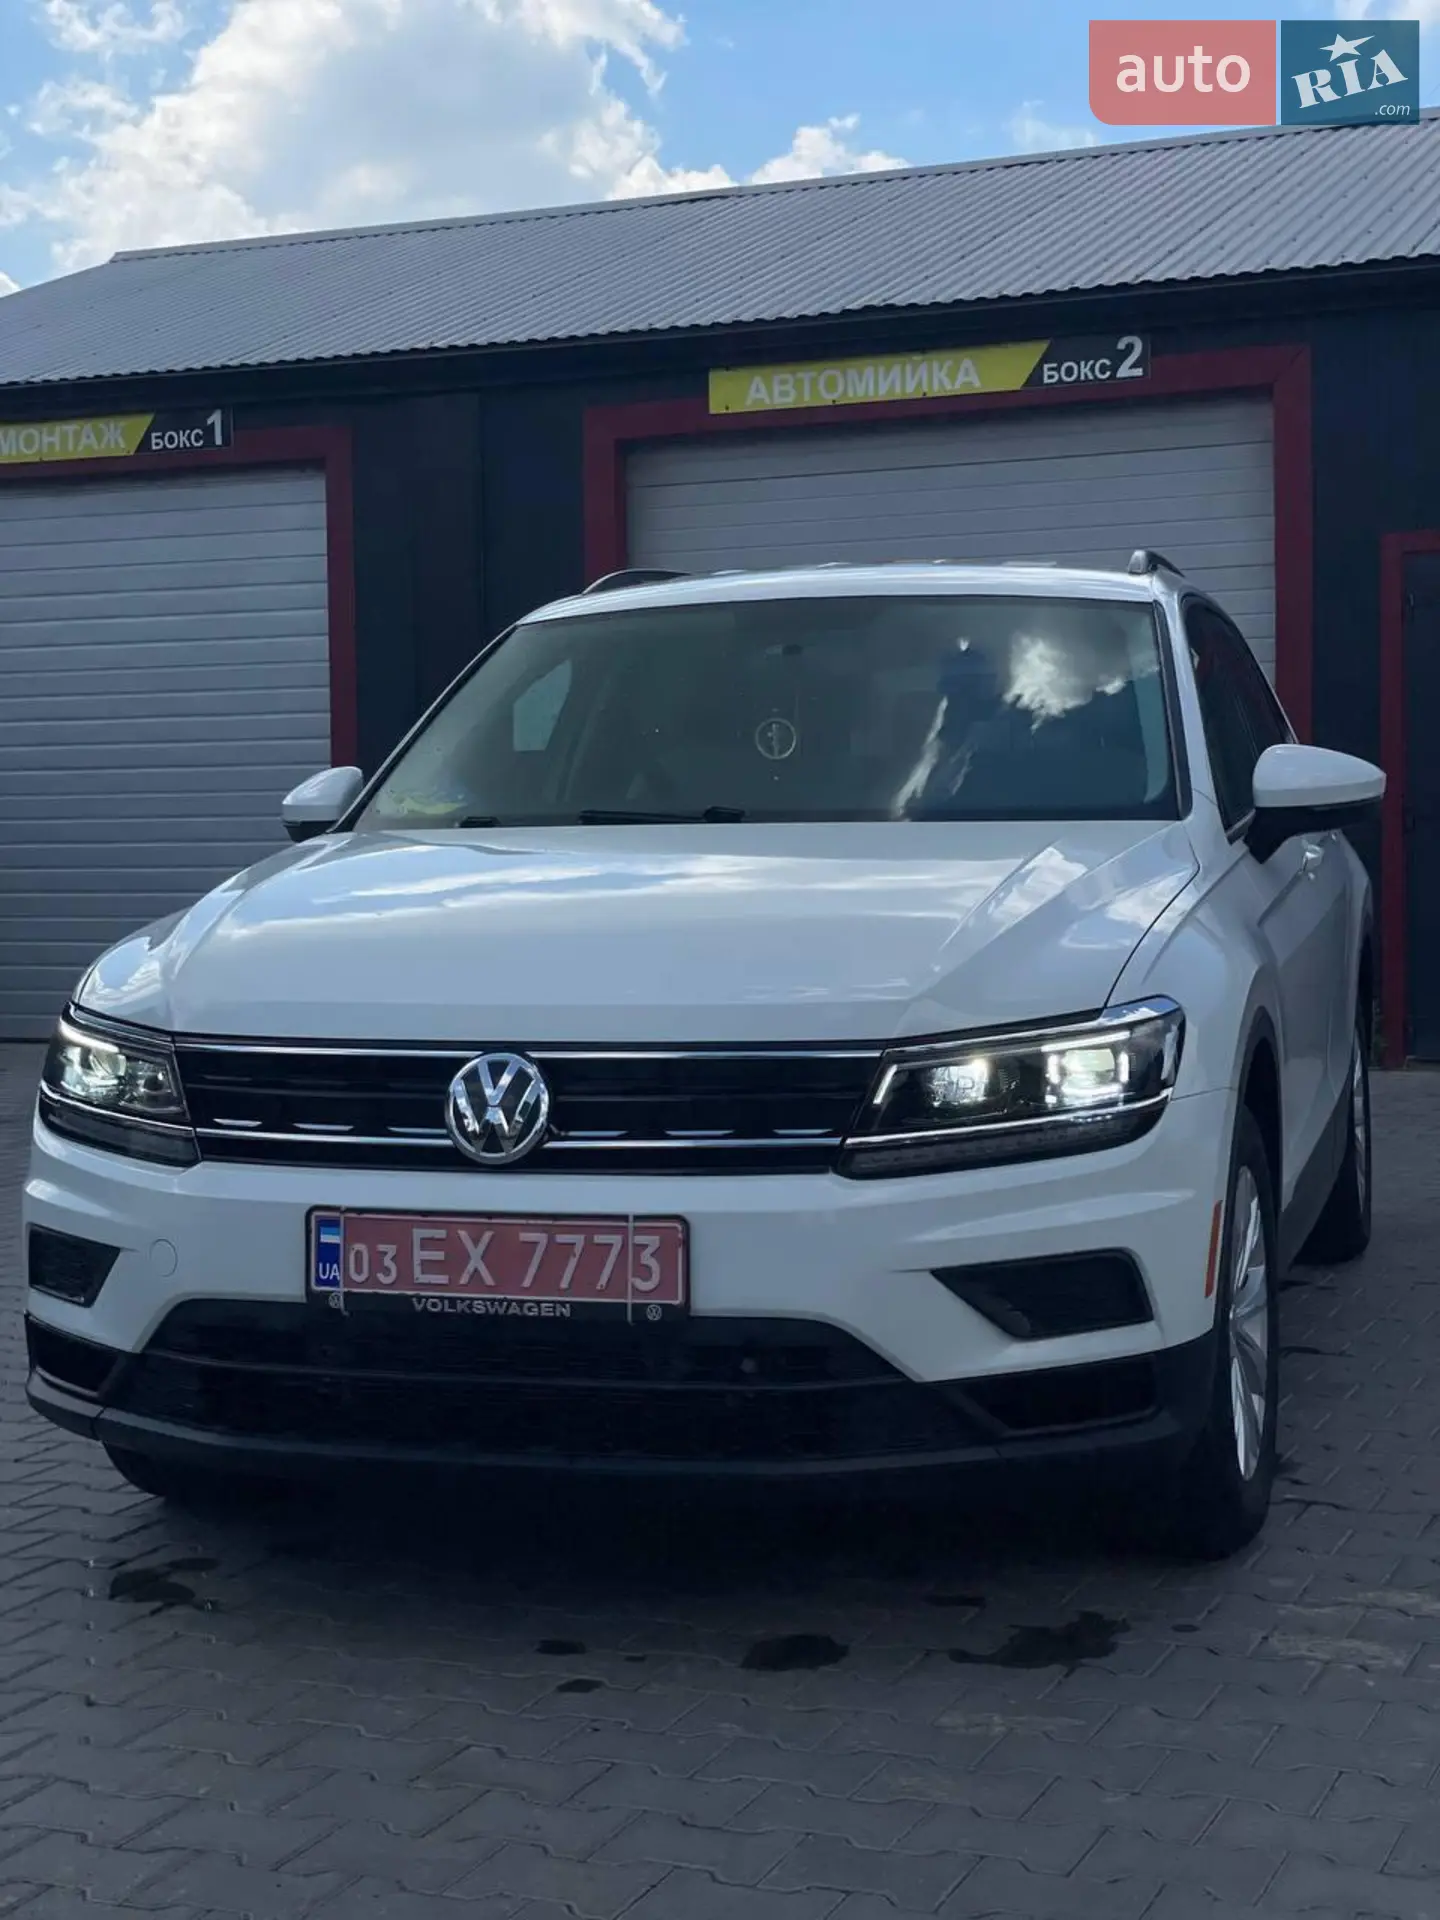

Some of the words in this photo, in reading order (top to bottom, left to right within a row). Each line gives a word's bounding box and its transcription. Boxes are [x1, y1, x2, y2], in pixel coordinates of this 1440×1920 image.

[1043, 358, 1112, 384] БОКС
[1115, 335, 1144, 379] 2
[151, 428, 205, 451] БОКС
[206, 409, 224, 446] 1
[318, 1261, 341, 1281] UA
[349, 1242, 398, 1285] 03
[412, 1227, 497, 1287] EX
[518, 1231, 662, 1293] 7773
[412, 1297, 572, 1318] VOLKSWAGEN
